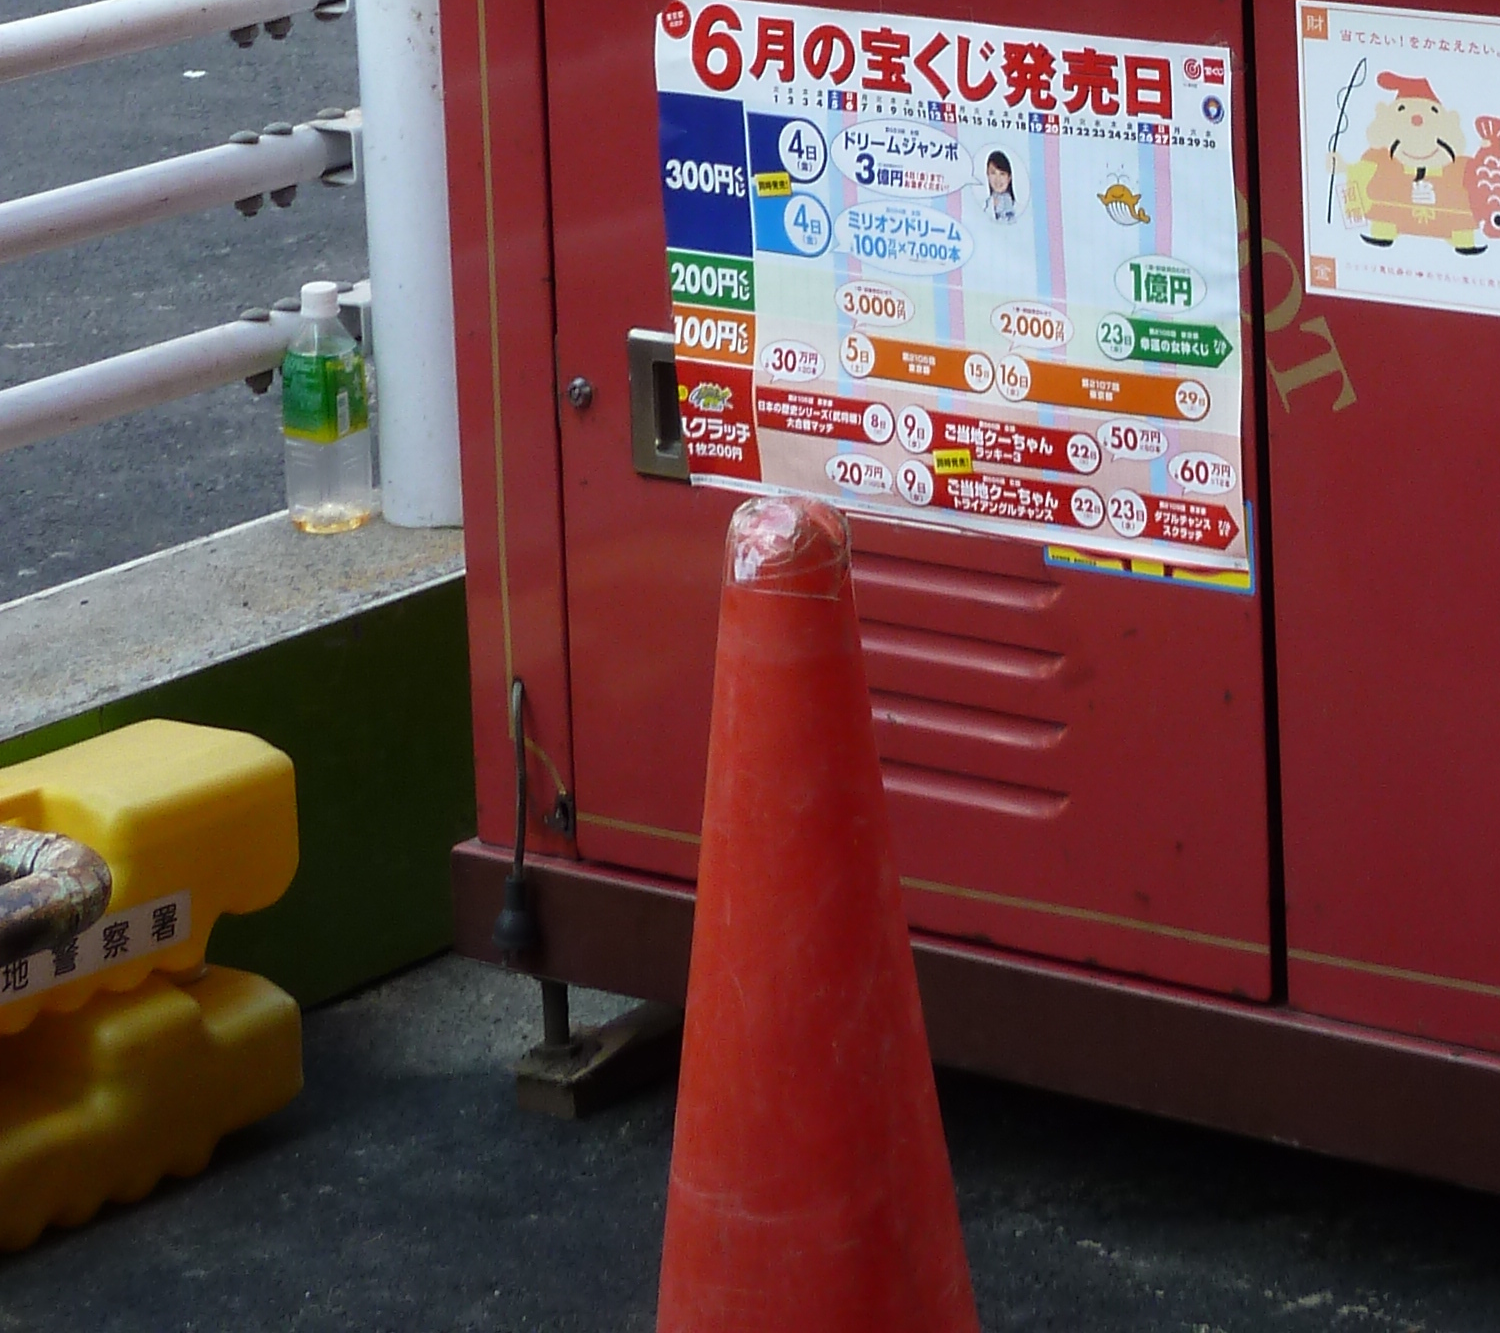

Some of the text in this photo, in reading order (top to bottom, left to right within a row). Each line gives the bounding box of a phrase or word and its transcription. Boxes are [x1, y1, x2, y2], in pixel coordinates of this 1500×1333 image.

[1306, 13, 1324, 32] 財
[690, 3, 1173, 121] 6月の宝くじ発売日
[787, 129, 818, 161] 4日
[842, 130, 959, 162] ドリームジャンボ
[665, 159, 746, 198] 300円くじ
[855, 152, 904, 188] 3億円
[793, 204, 822, 235] 4日
[847, 210, 962, 242] ミリオンドリーム
[671, 261, 750, 301] 200円くじ
[1128, 262, 1194, 308] 1億円
[843, 291, 907, 321] 3,000万円
[674, 315, 749, 355] 100円くじ
[1000, 313, 1066, 343] 2,000万円
[1101, 322, 1133, 346] 23日
[845, 337, 870, 363] 5日
[999, 364, 1029, 389] 16日
[903, 414, 926, 441] 9日
[686, 442, 743, 462] 1枚200円
[903, 469, 927, 495] 9日
[1111, 496, 1145, 522] 23日
